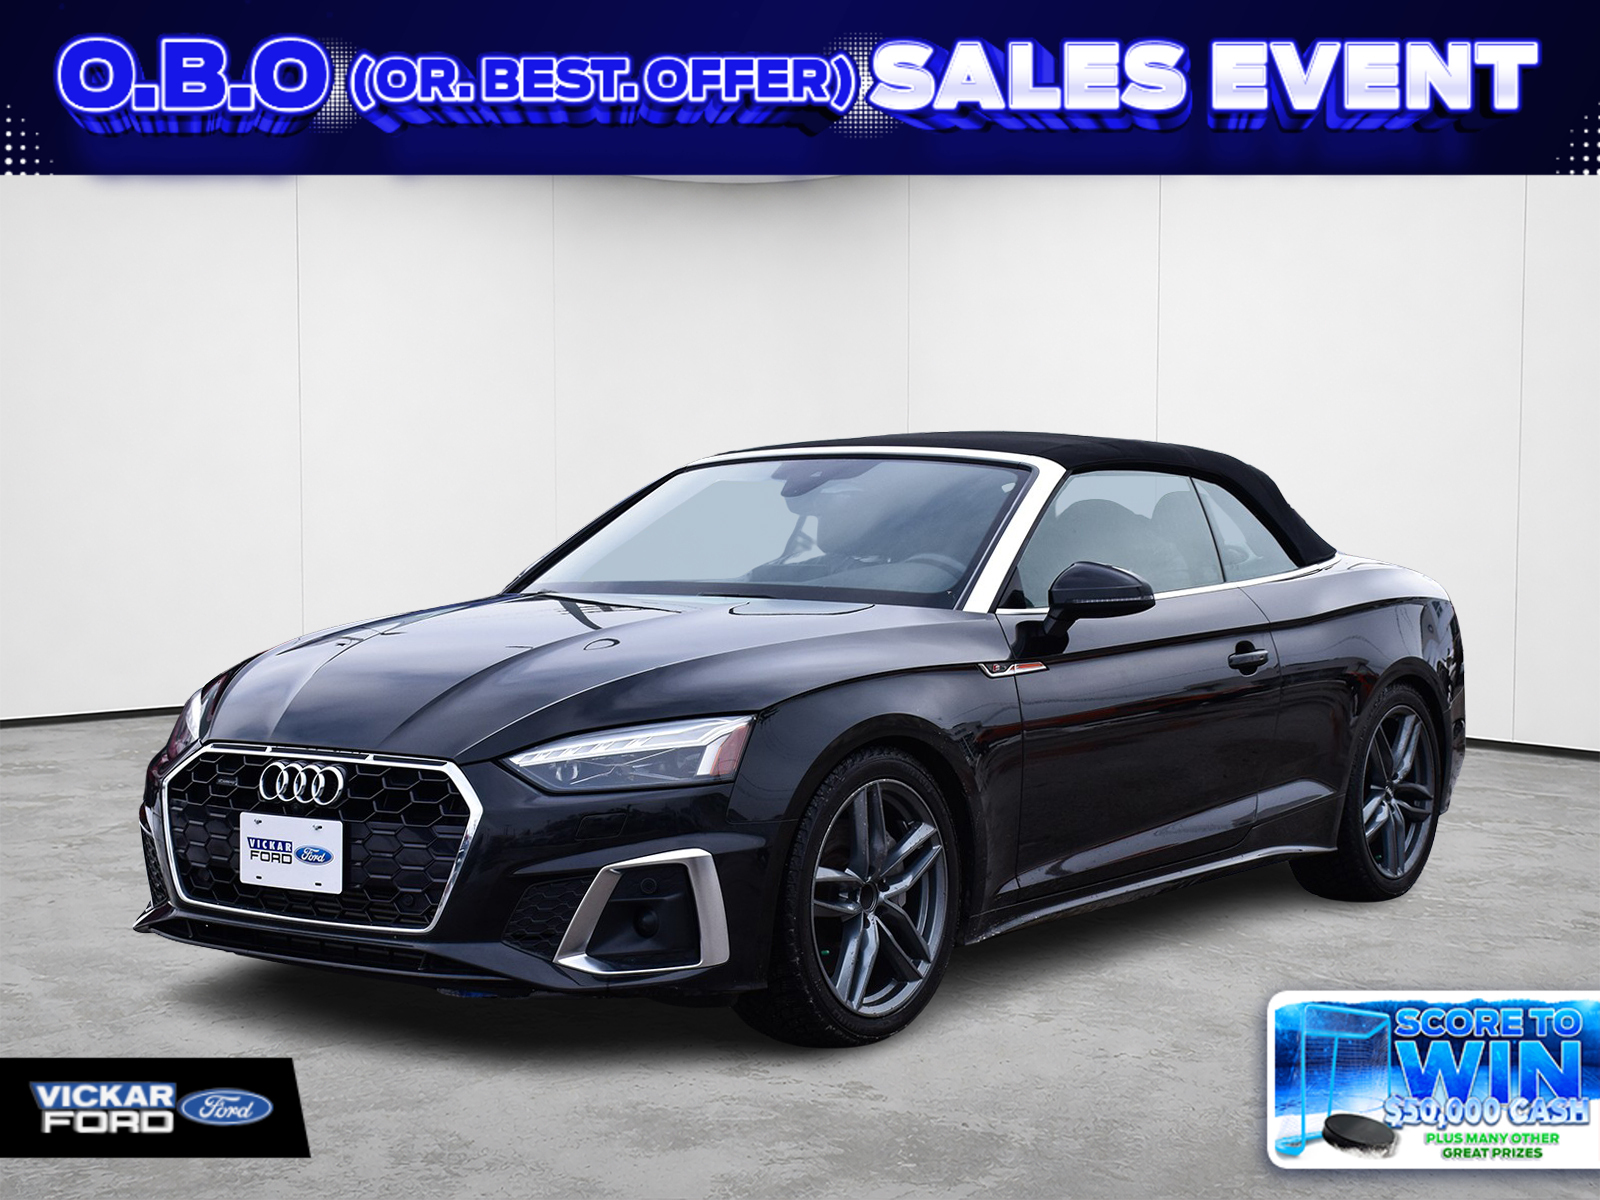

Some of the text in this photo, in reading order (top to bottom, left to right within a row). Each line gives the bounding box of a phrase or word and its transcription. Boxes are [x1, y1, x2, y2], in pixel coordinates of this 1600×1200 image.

[249, 838, 292, 852] VICKAR
[250, 851, 292, 864] FORD
[301, 847, 326, 863] Ford
